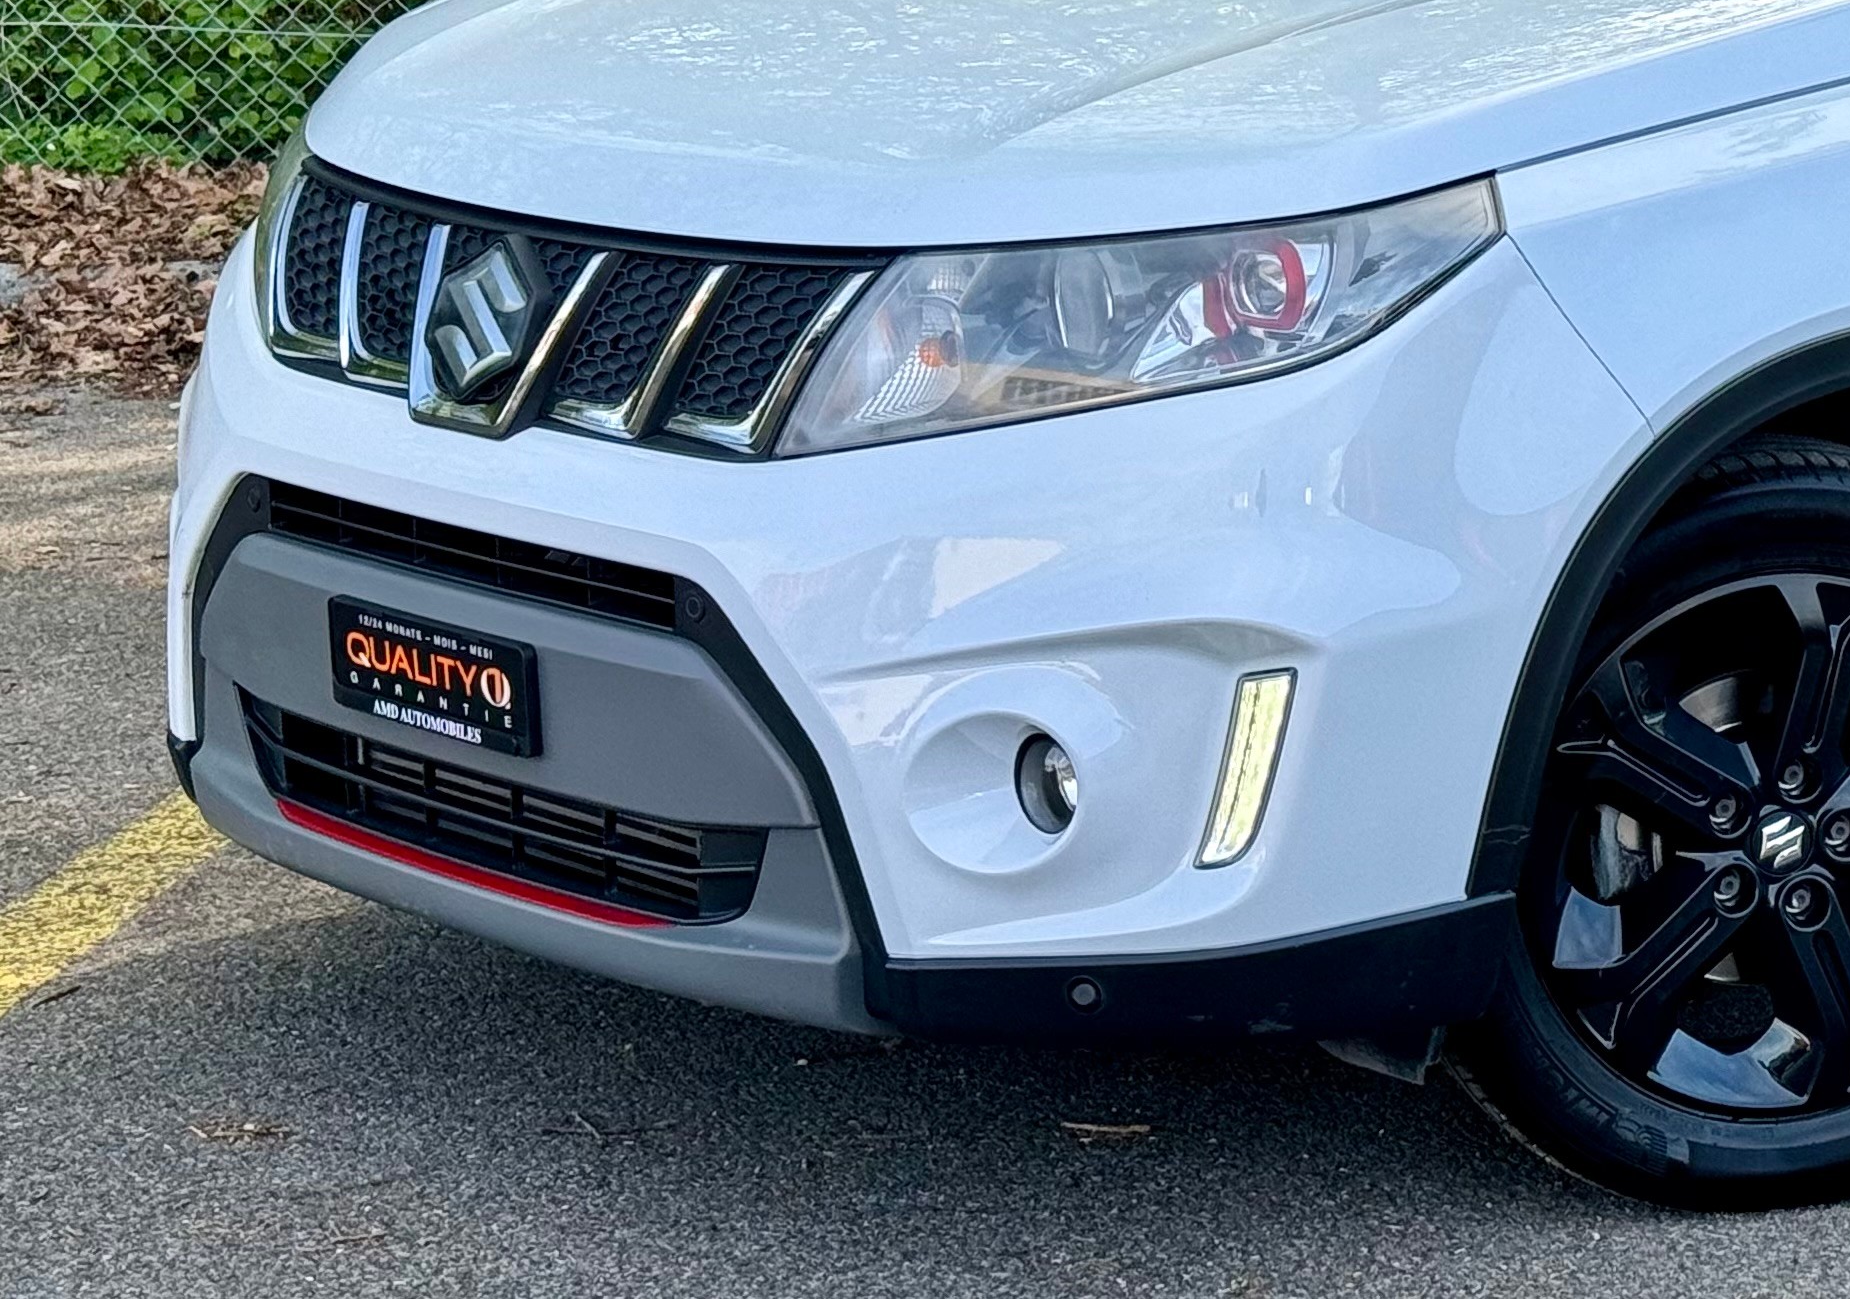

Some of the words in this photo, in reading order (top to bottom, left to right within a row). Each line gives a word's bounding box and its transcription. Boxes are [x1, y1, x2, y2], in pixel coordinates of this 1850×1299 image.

[346, 630, 478, 698] QUALITY
[350, 670, 513, 729] GARANTIE
[373, 699, 400, 720] AMD
[400, 708, 483, 745] AUTOMOBILES
